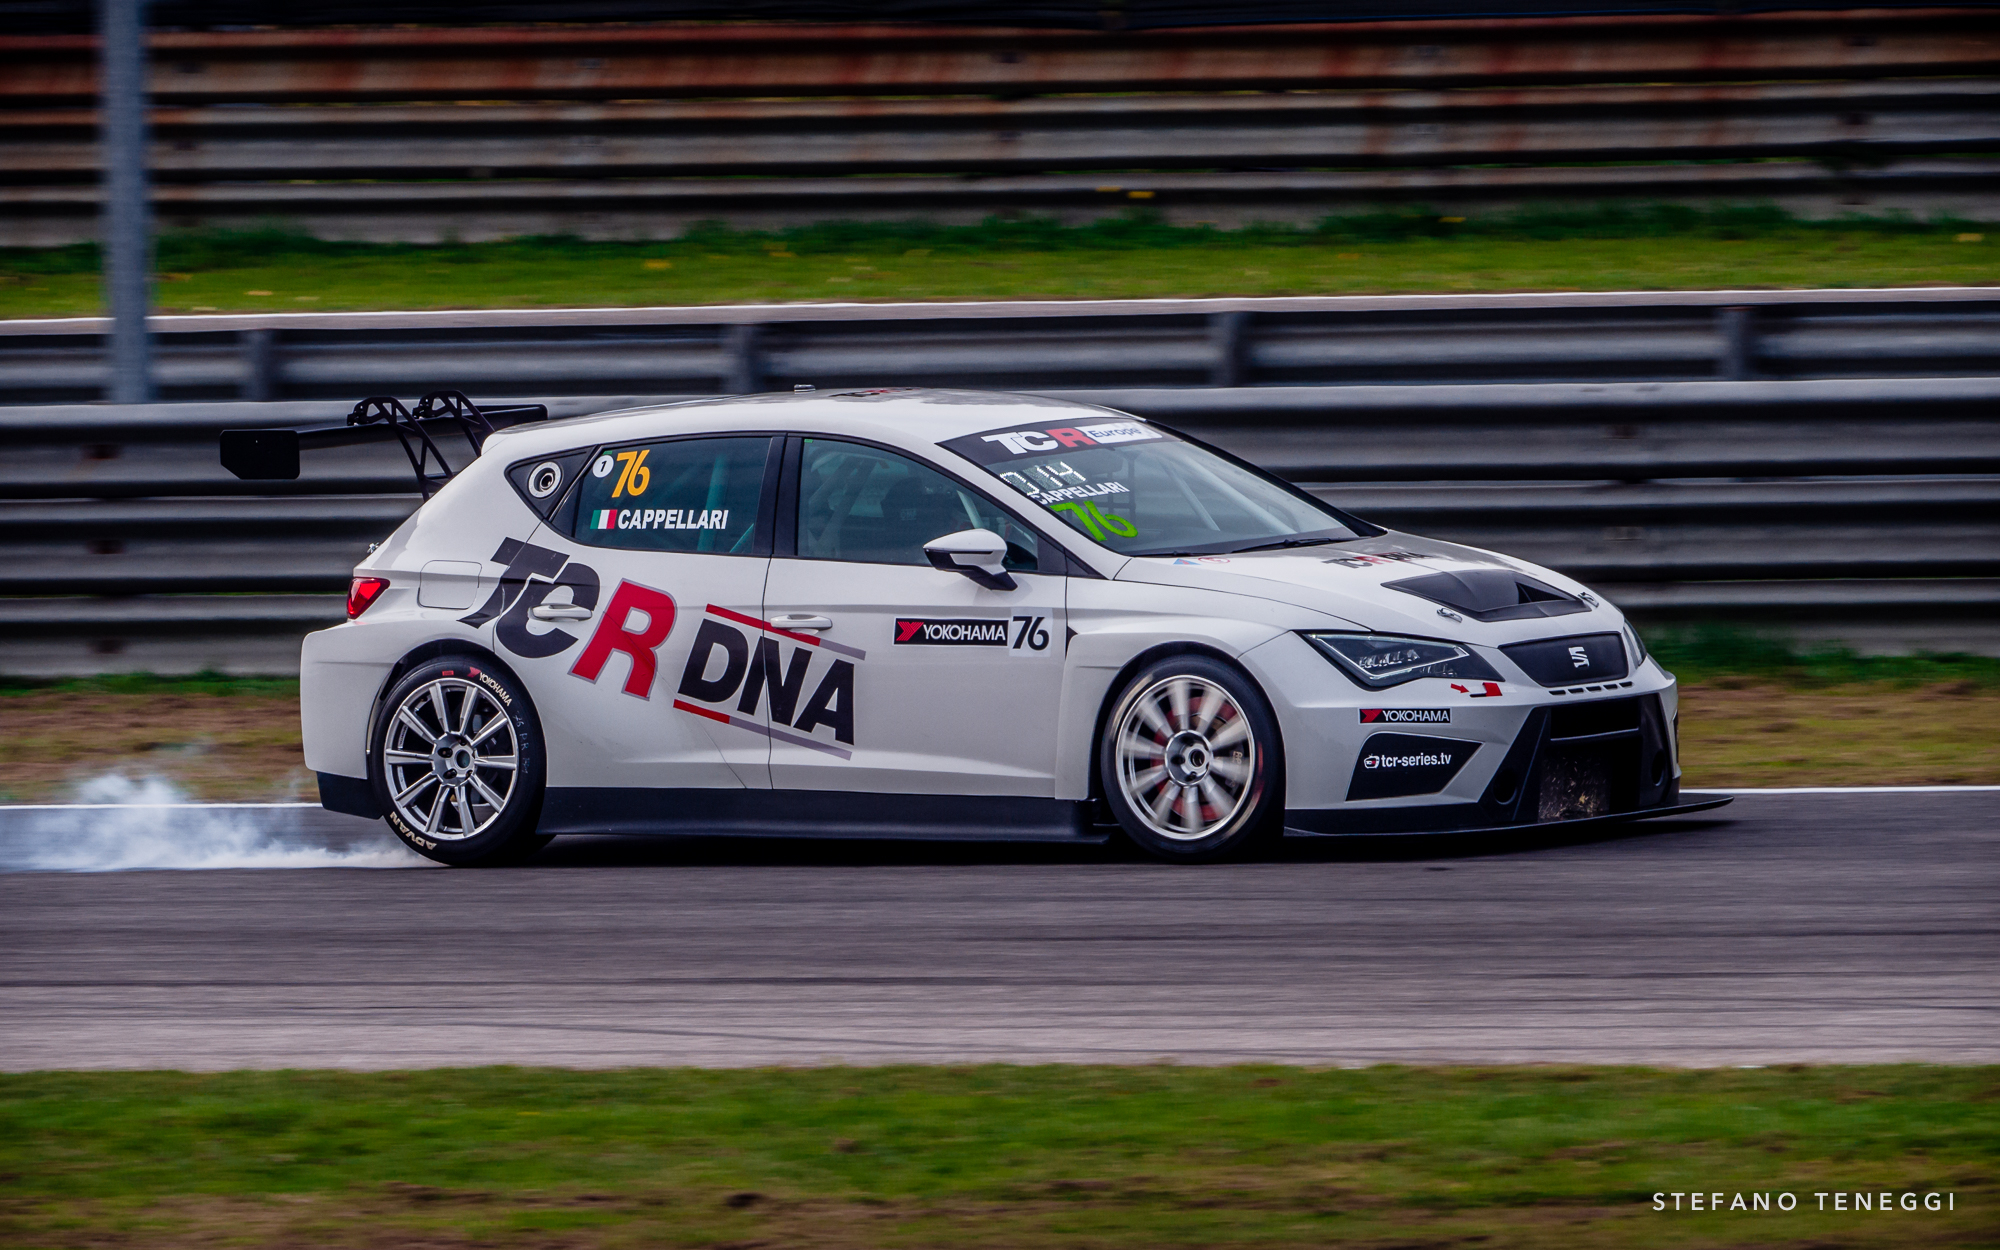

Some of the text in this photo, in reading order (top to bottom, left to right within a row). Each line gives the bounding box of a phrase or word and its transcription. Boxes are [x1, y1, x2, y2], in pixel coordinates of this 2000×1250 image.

[981, 425, 1142, 455] TCR Europe
[600, 449, 650, 498] 1 76
[1030, 481, 1130, 506] CAPPELLARI
[617, 509, 729, 530] CAPPELLARI
[1050, 500, 1138, 541] 76
[456, 537, 855, 745] TCR DNA
[923, 615, 1050, 651] YOKOHAMA 76
[480, 671, 512, 706] YOKOHAMA
[1382, 710, 1449, 722] YOKOHAMA
[1381, 752, 1452, 768] tcr-series.tv
[390, 810, 437, 850] ADVAN
